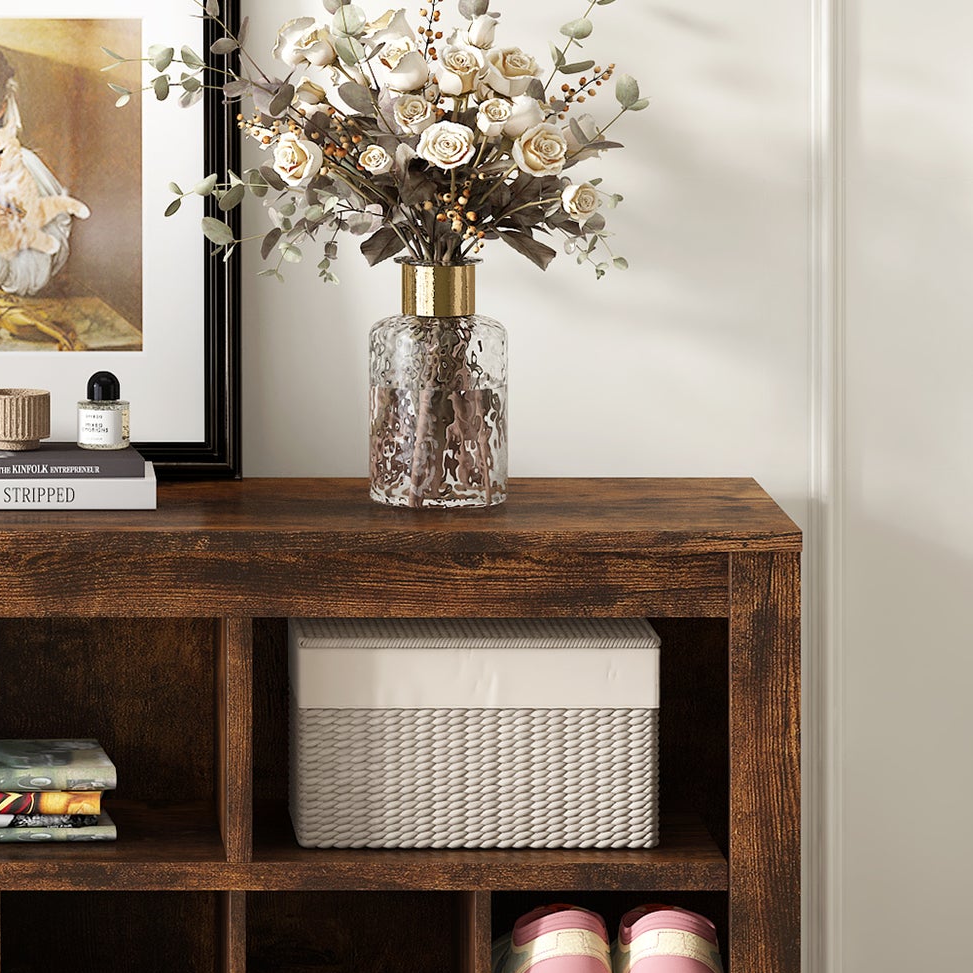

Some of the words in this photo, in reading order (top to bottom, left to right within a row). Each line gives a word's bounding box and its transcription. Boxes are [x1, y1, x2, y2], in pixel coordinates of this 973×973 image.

[12, 464, 48, 474] KINFOLK
[50, 466, 100, 474] ENTREPRENEUR
[3, 487, 75, 503] STRIPPED
